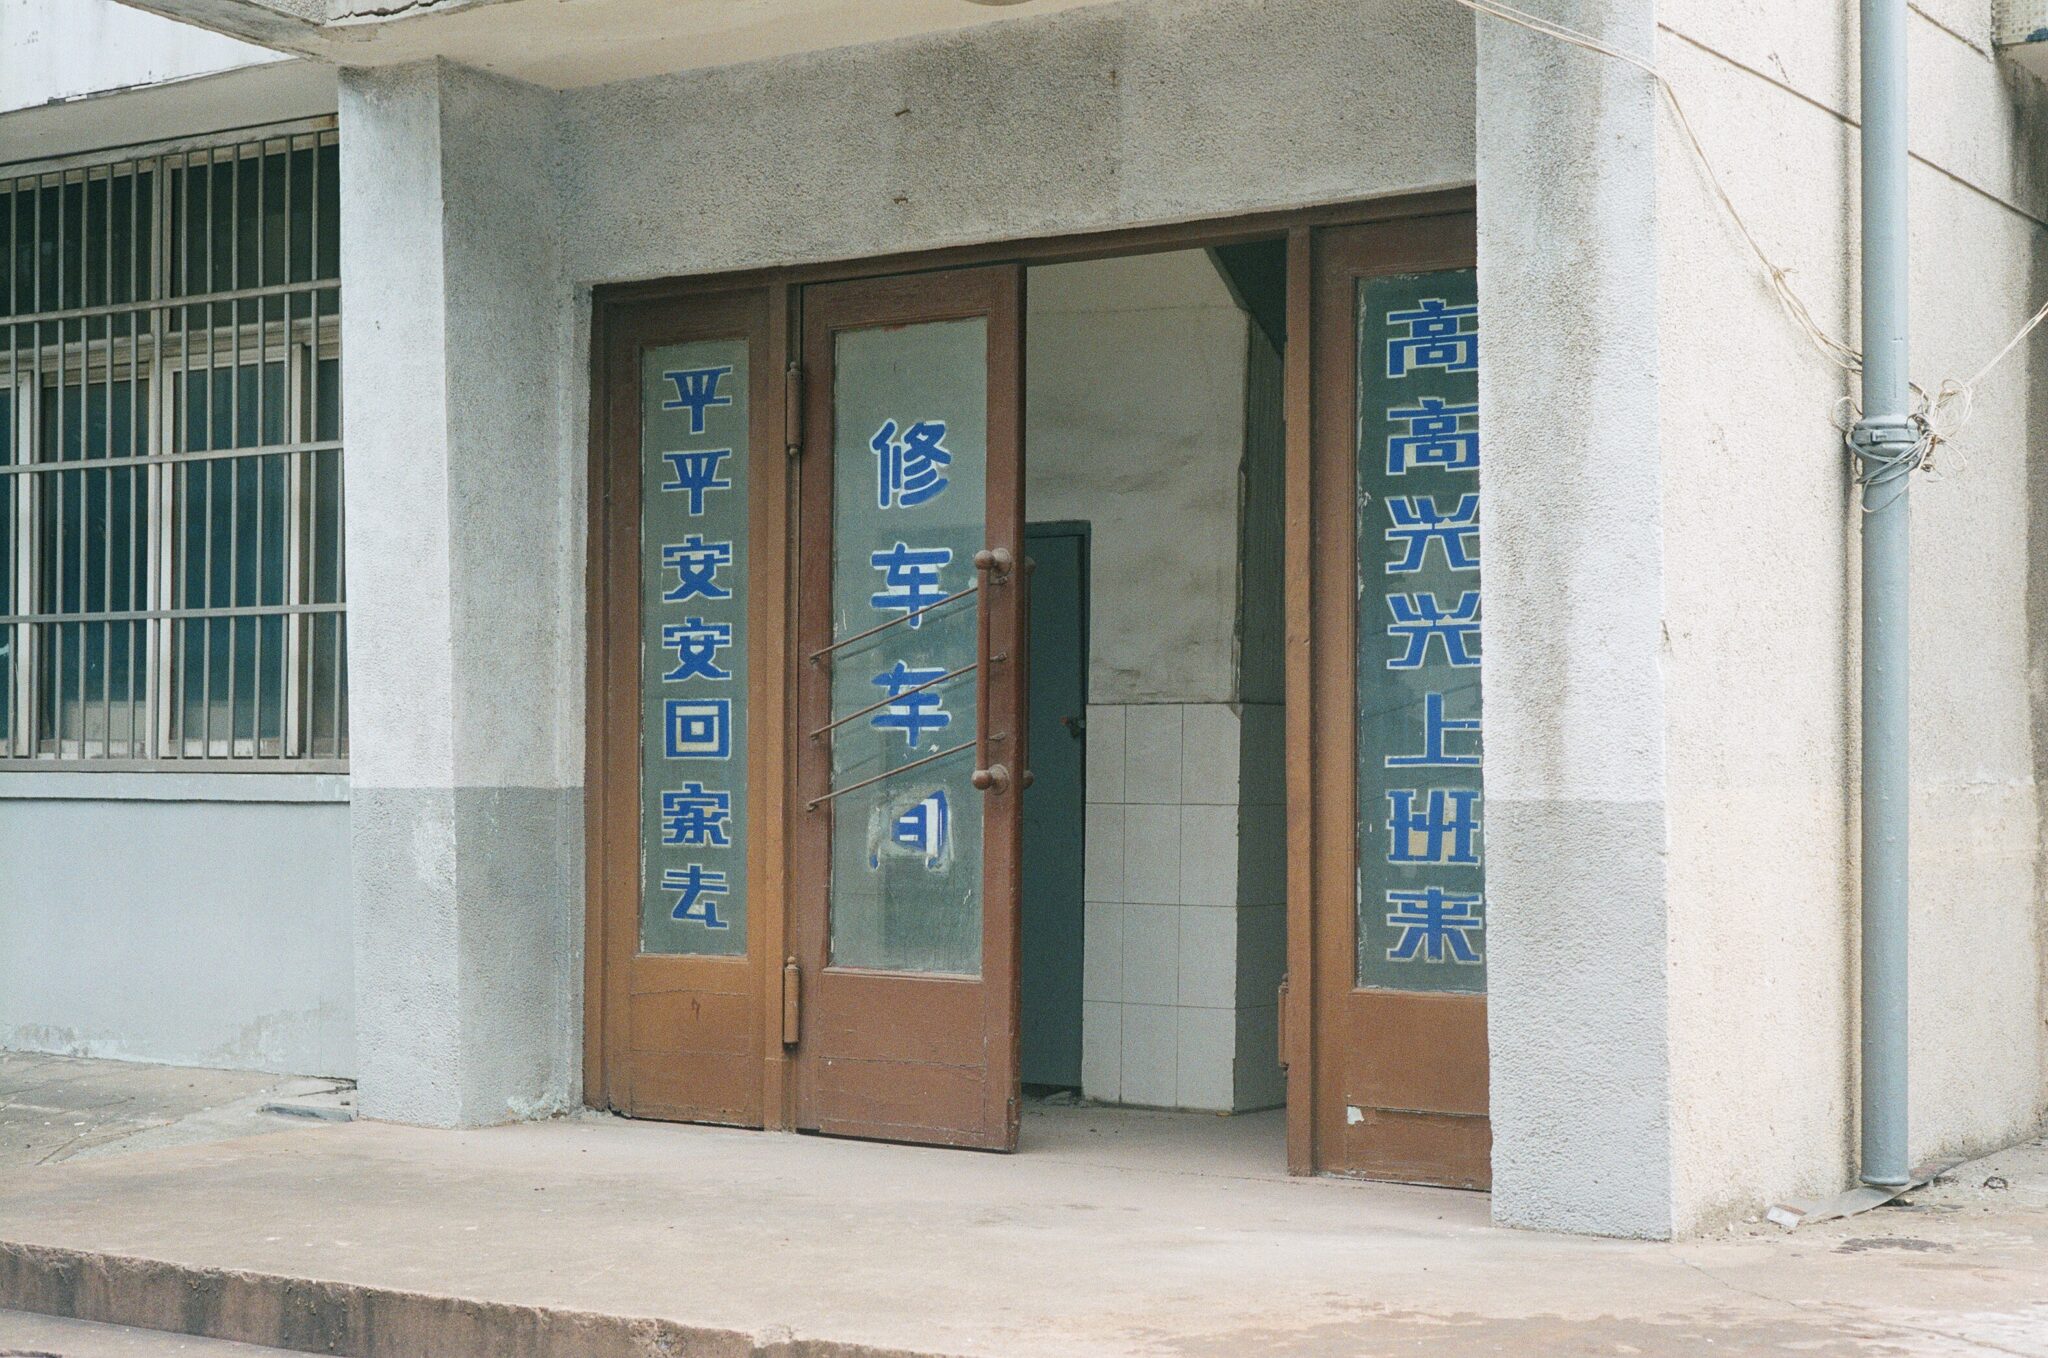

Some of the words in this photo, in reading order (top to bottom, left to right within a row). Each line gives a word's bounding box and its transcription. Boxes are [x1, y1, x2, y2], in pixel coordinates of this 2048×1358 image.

[662, 365, 732, 929] 平平安安回家去
[1385, 298, 1482, 965] 高高兴兴上班来
